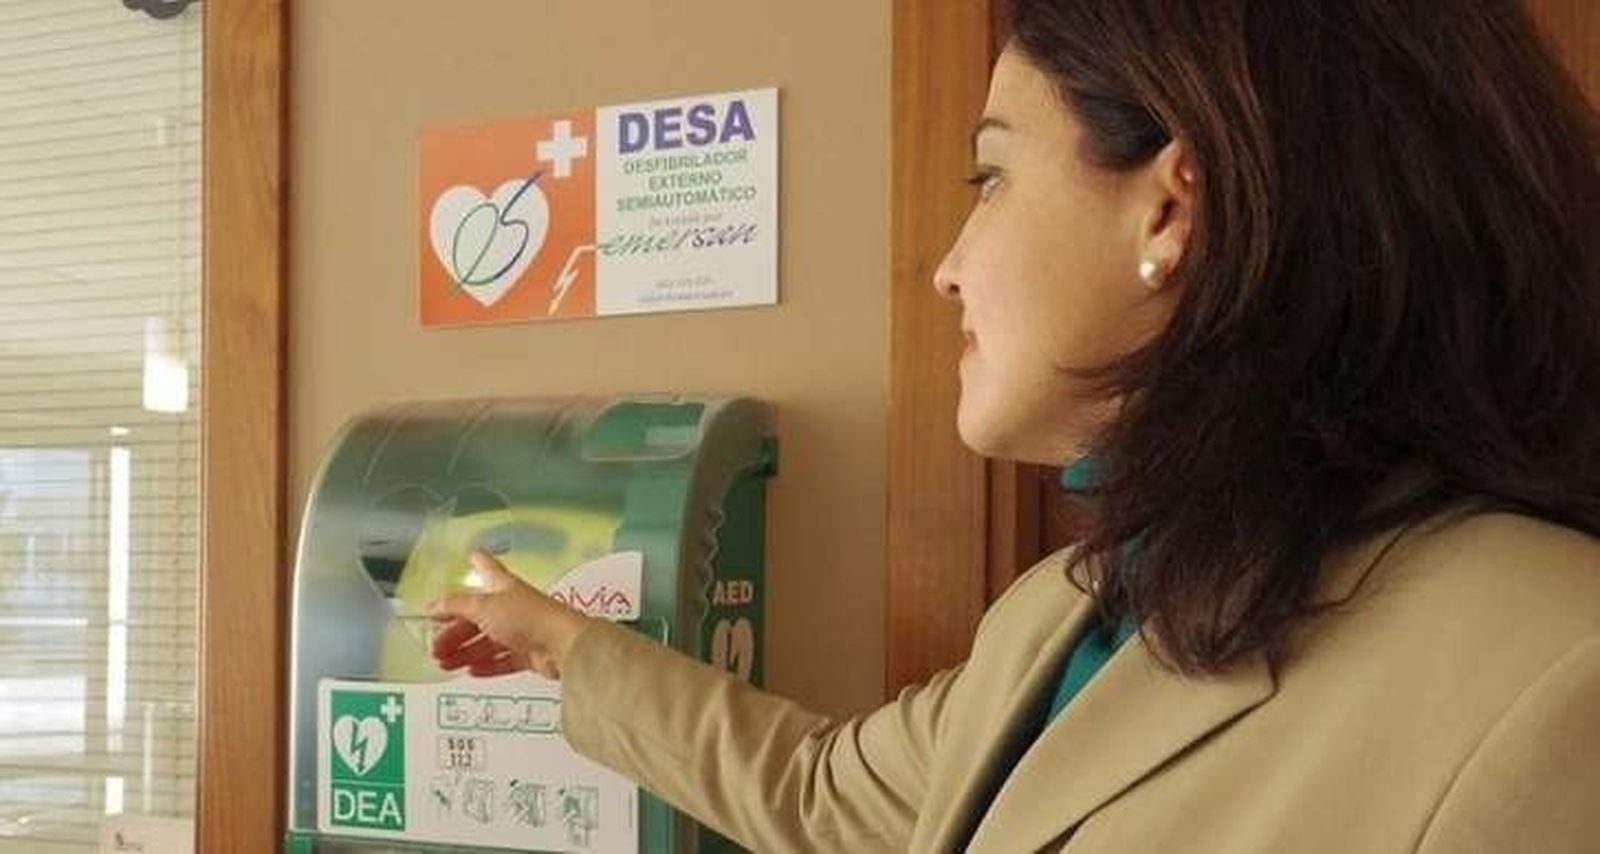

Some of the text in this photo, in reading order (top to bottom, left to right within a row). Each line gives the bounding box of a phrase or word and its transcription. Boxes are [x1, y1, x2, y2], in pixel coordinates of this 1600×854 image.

[618, 99, 755, 155] DESA
[623, 149, 748, 175] DESFIBRILADOR
[648, 169, 723, 191] EXTERNO
[712, 580, 754, 606] AED
[333, 789, 402, 826] DEA
